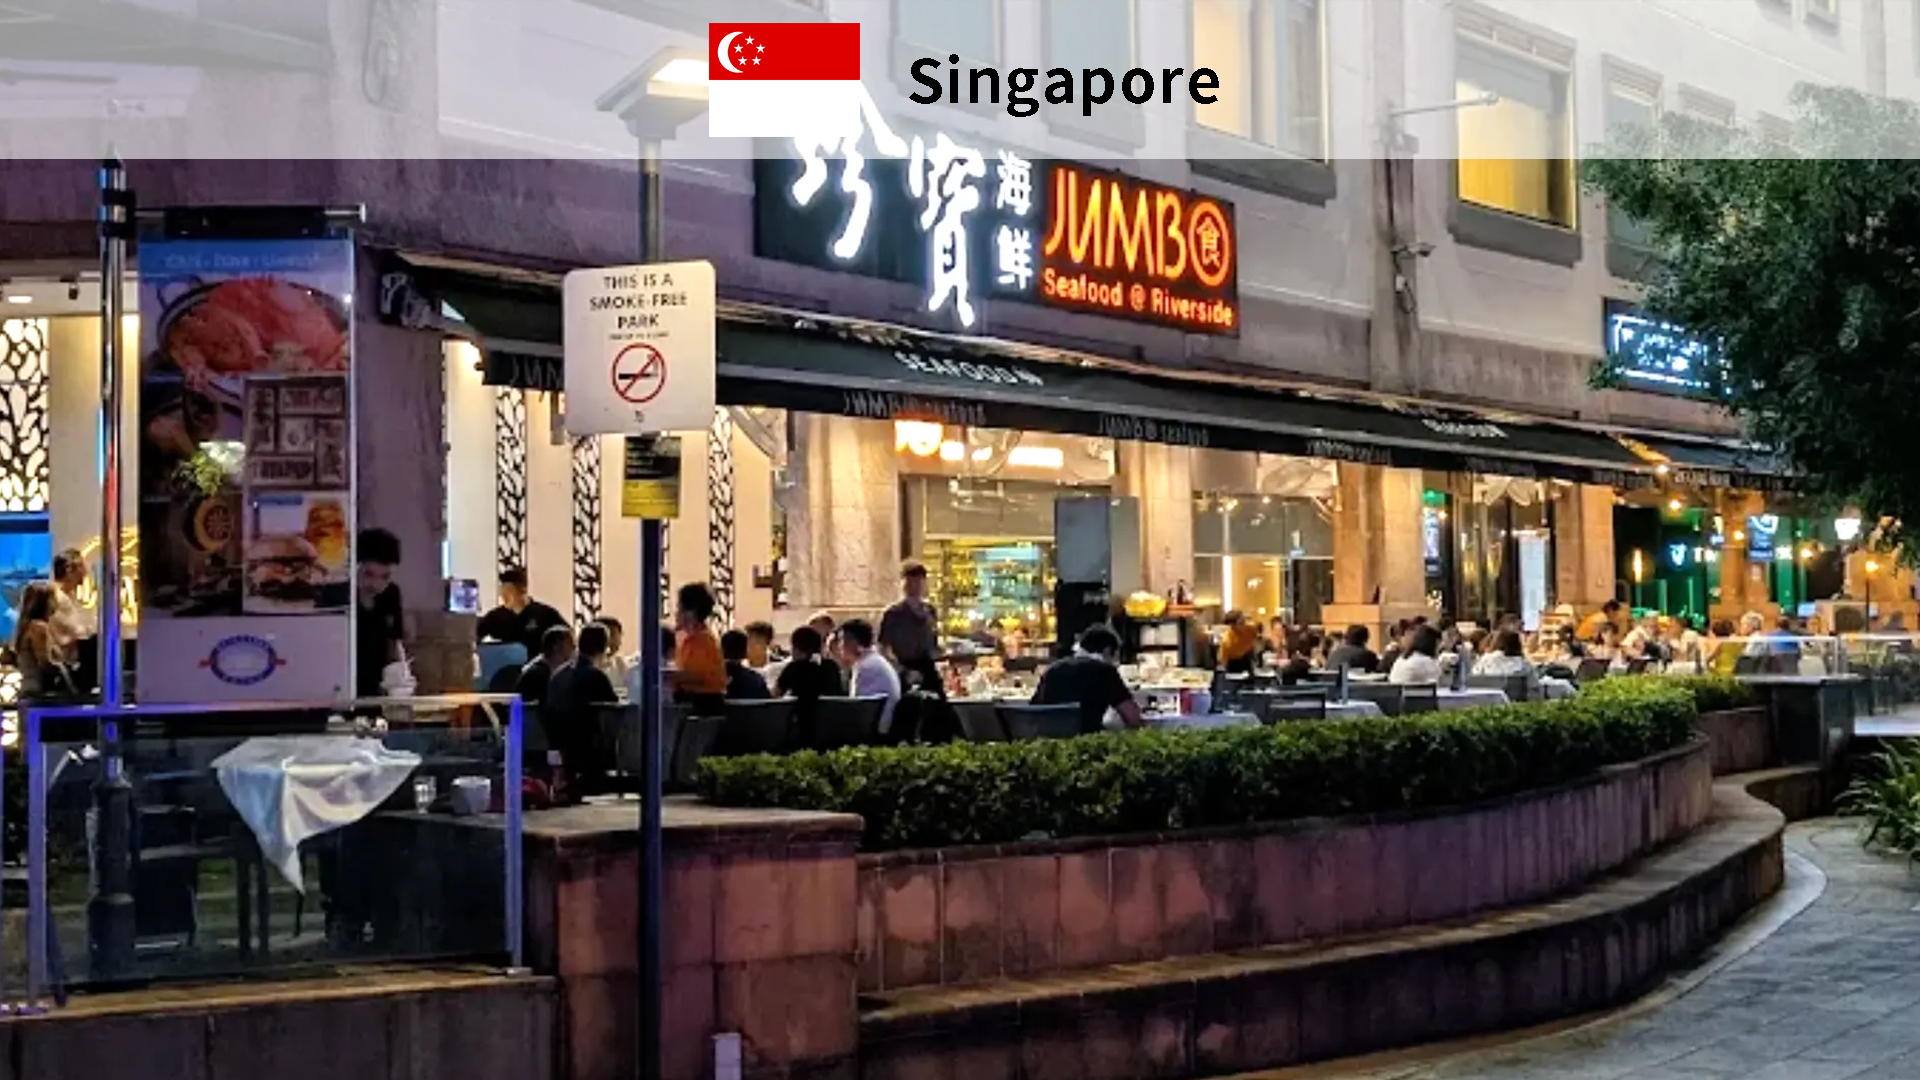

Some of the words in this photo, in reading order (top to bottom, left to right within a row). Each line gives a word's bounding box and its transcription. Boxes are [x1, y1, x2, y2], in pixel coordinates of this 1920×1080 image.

[996, 150, 1033, 290] 海鮮
[603, 274, 638, 290] THIS
[644, 273, 657, 287] IS
[661, 273, 674, 287] A
[589, 294, 689, 312] SMOKE-FREE
[1044, 267, 1123, 307] Seafood
[1130, 285, 1144, 312] @
[1151, 291, 1234, 328] Riverside
[617, 313, 660, 330] PARK
